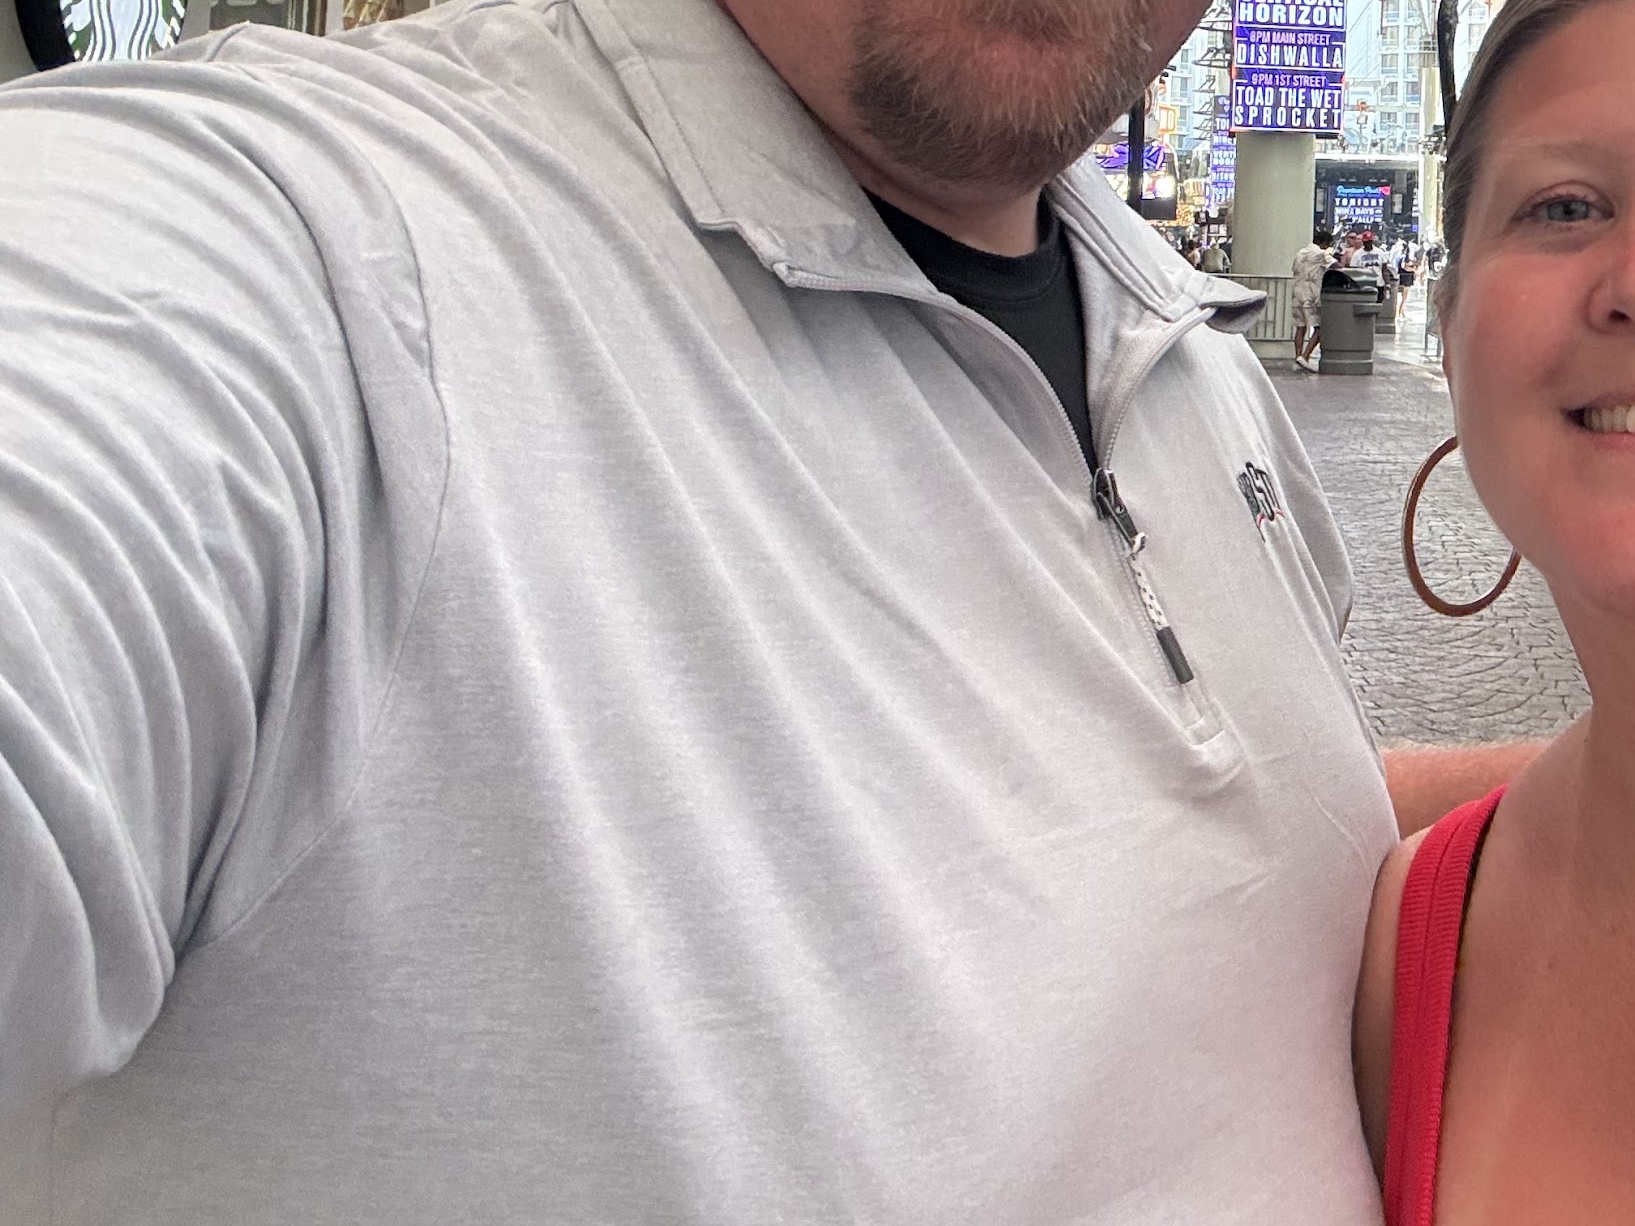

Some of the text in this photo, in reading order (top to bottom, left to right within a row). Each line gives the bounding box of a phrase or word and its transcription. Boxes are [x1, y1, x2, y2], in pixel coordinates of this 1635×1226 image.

[1239, 2, 1343, 27] HORIZON
[1250, 30, 1330, 46] 8PM MAIN STREET
[1236, 43, 1343, 68] DISHWALLA
[1252, 73, 1326, 87] 9PM 1ST STREET
[1236, 85, 1274, 106] TOAD
[1279, 87, 1306, 107] THE
[1310, 89, 1342, 109] WET
[1234, 105, 1341, 128] SPROCKET
[1335, 197, 1384, 206] TONIGHT
